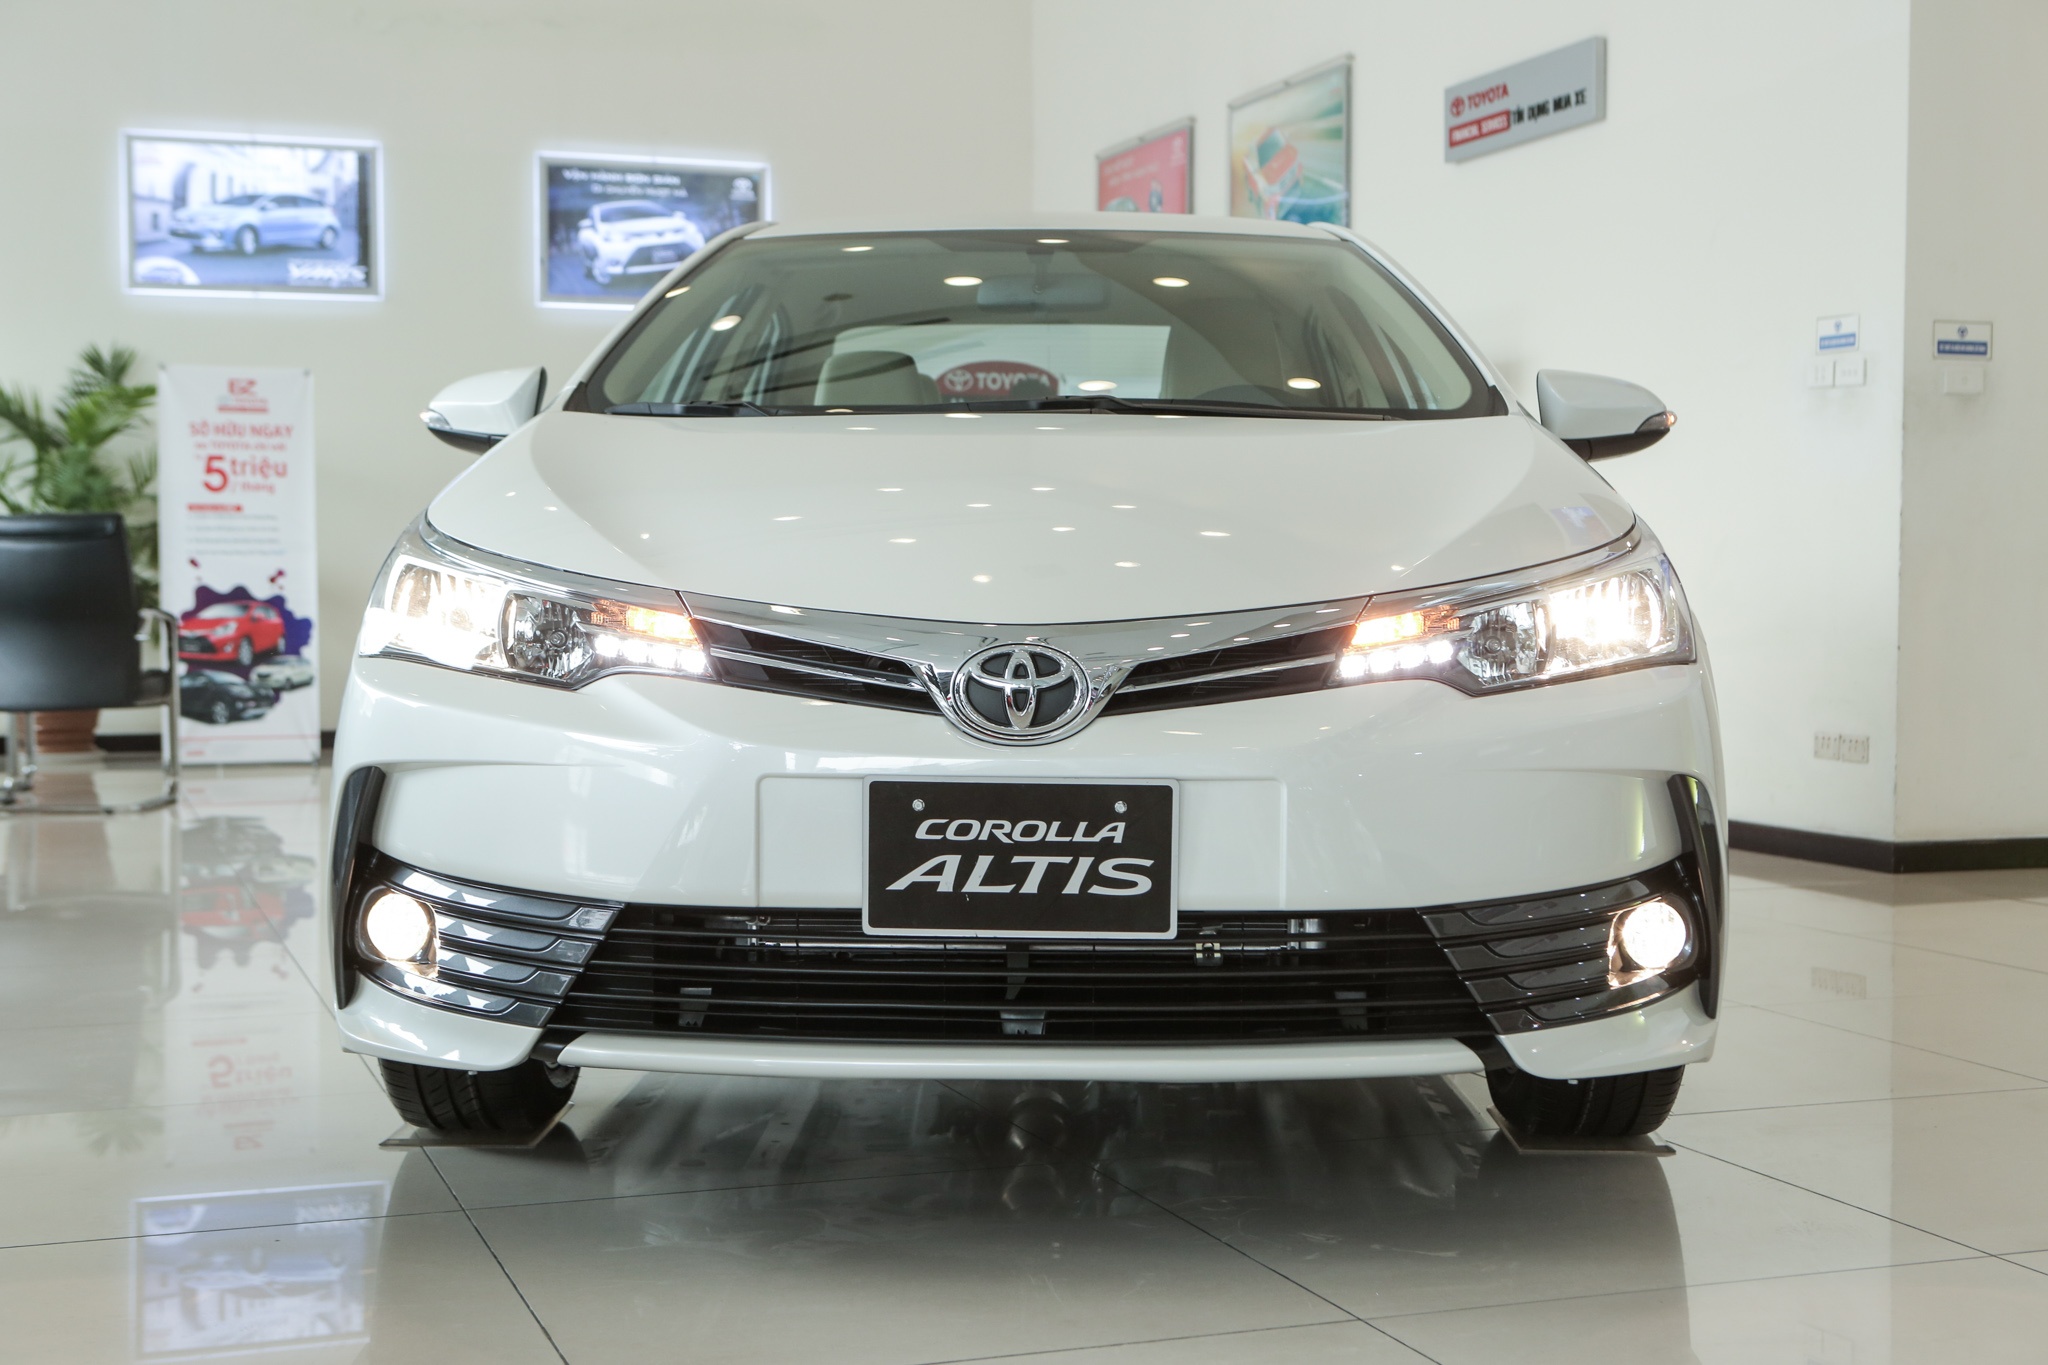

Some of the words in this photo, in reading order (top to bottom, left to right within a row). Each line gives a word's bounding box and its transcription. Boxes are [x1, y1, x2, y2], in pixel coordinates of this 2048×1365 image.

[1467, 83, 1509, 110] TOYOTA
[1574, 88, 1587, 105] XE
[204, 455, 228, 492] 5
[230, 456, 288, 479] triệu
[915, 818, 1126, 844] COROLLA
[885, 854, 1155, 896] ALTIS
